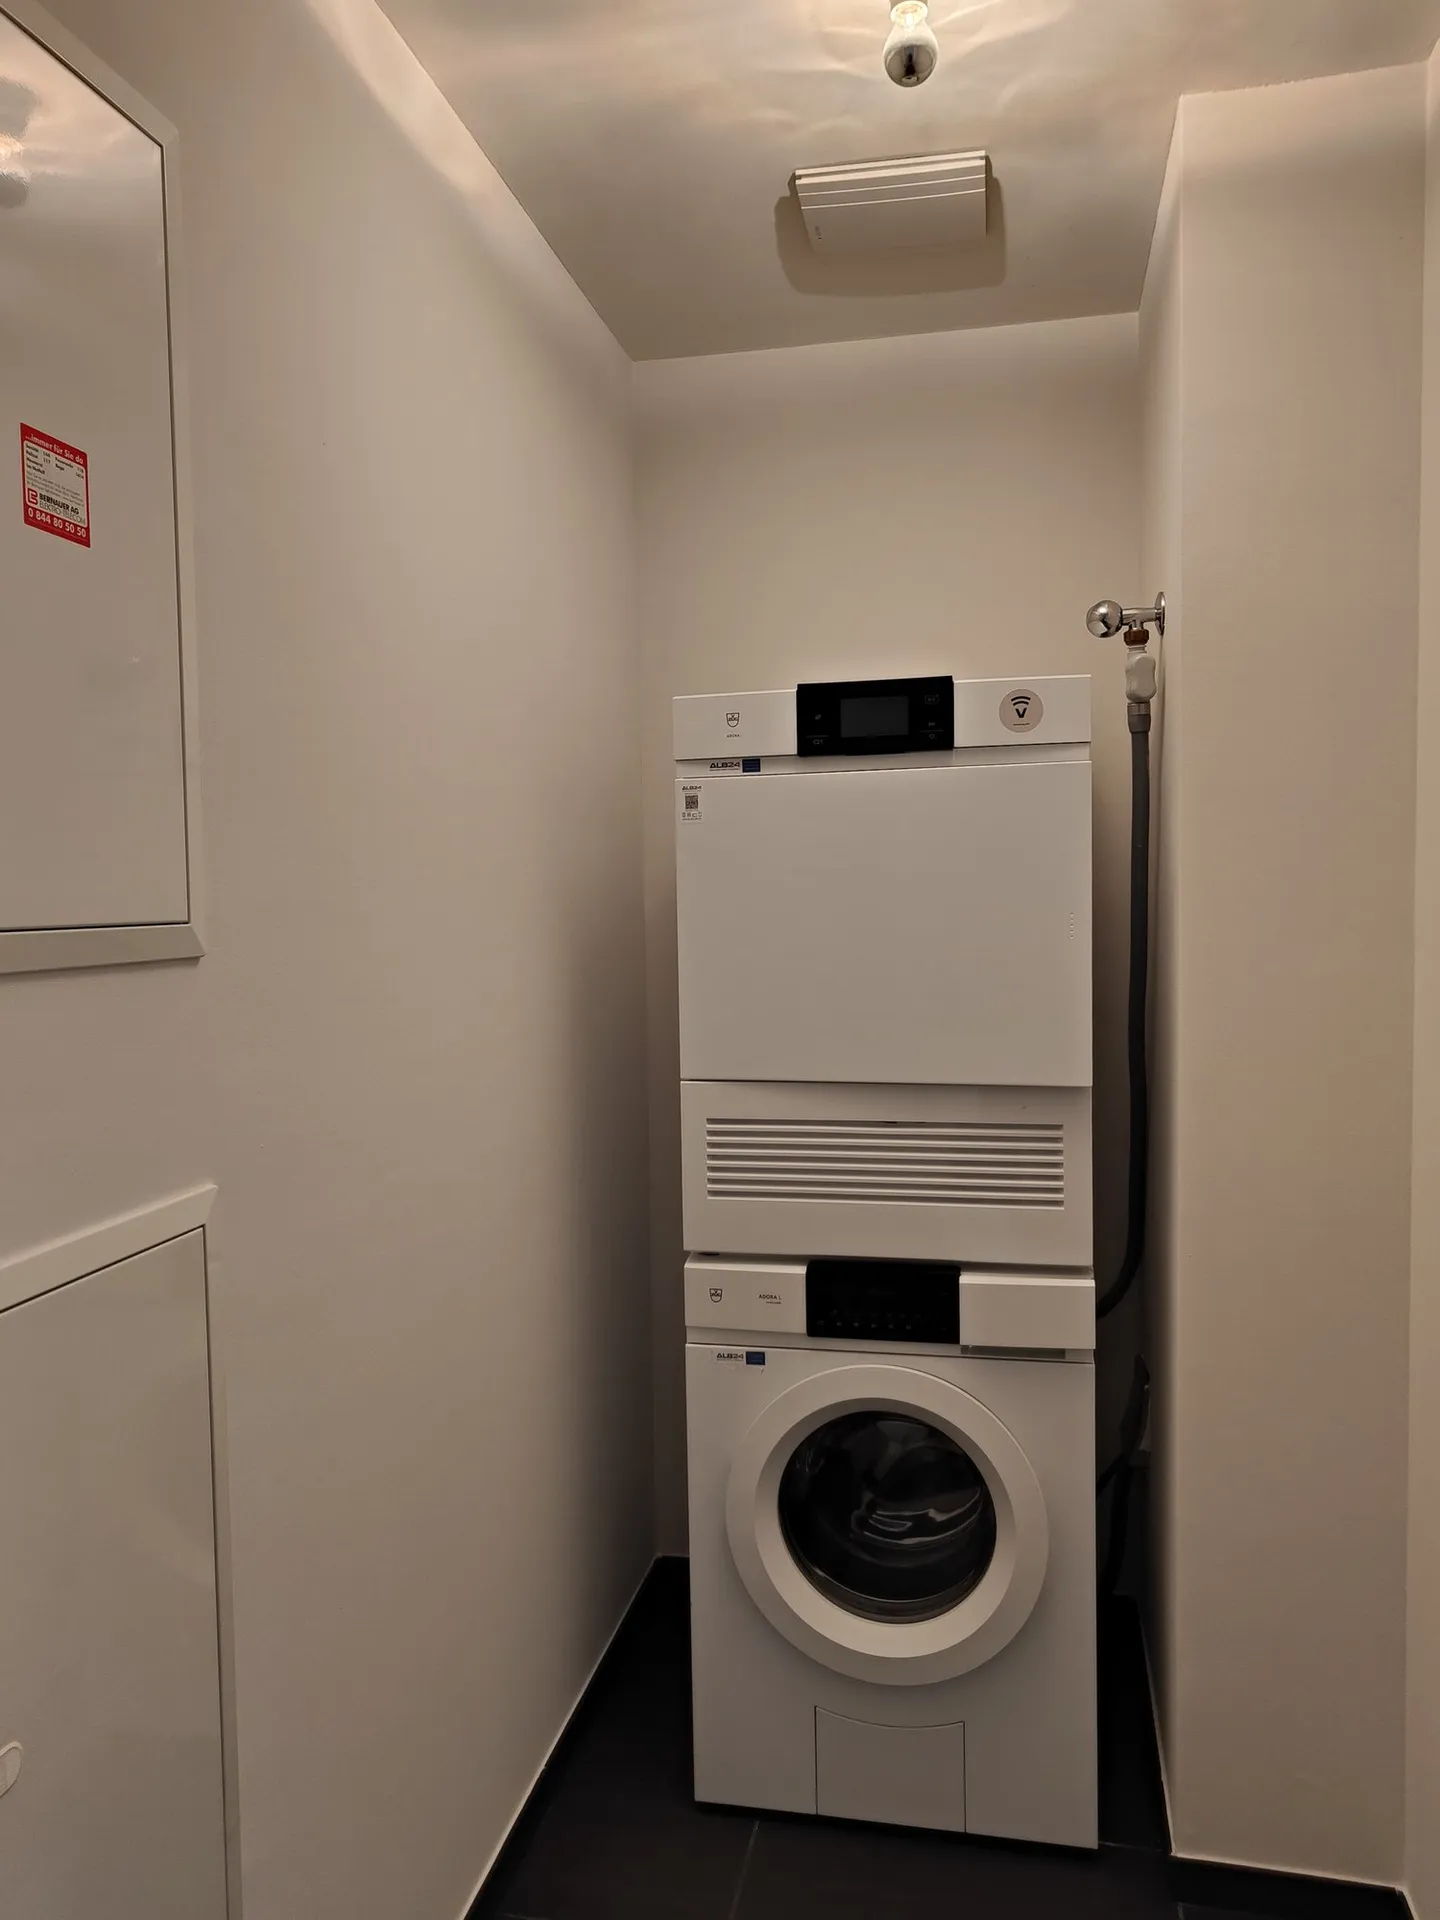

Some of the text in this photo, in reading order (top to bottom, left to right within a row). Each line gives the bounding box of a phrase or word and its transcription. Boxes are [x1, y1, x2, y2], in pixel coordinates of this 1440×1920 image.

[64, 449, 74, 460] Sie
[75, 455, 84, 465] da
[39, 492, 70, 511] BERNAUER
[70, 506, 80, 515] AG
[27, 507, 34, 518] 0
[35, 510, 51, 525] 844
[53, 517, 63, 529] 80
[65, 521, 75, 534] 50
[76, 526, 87, 538] 50
